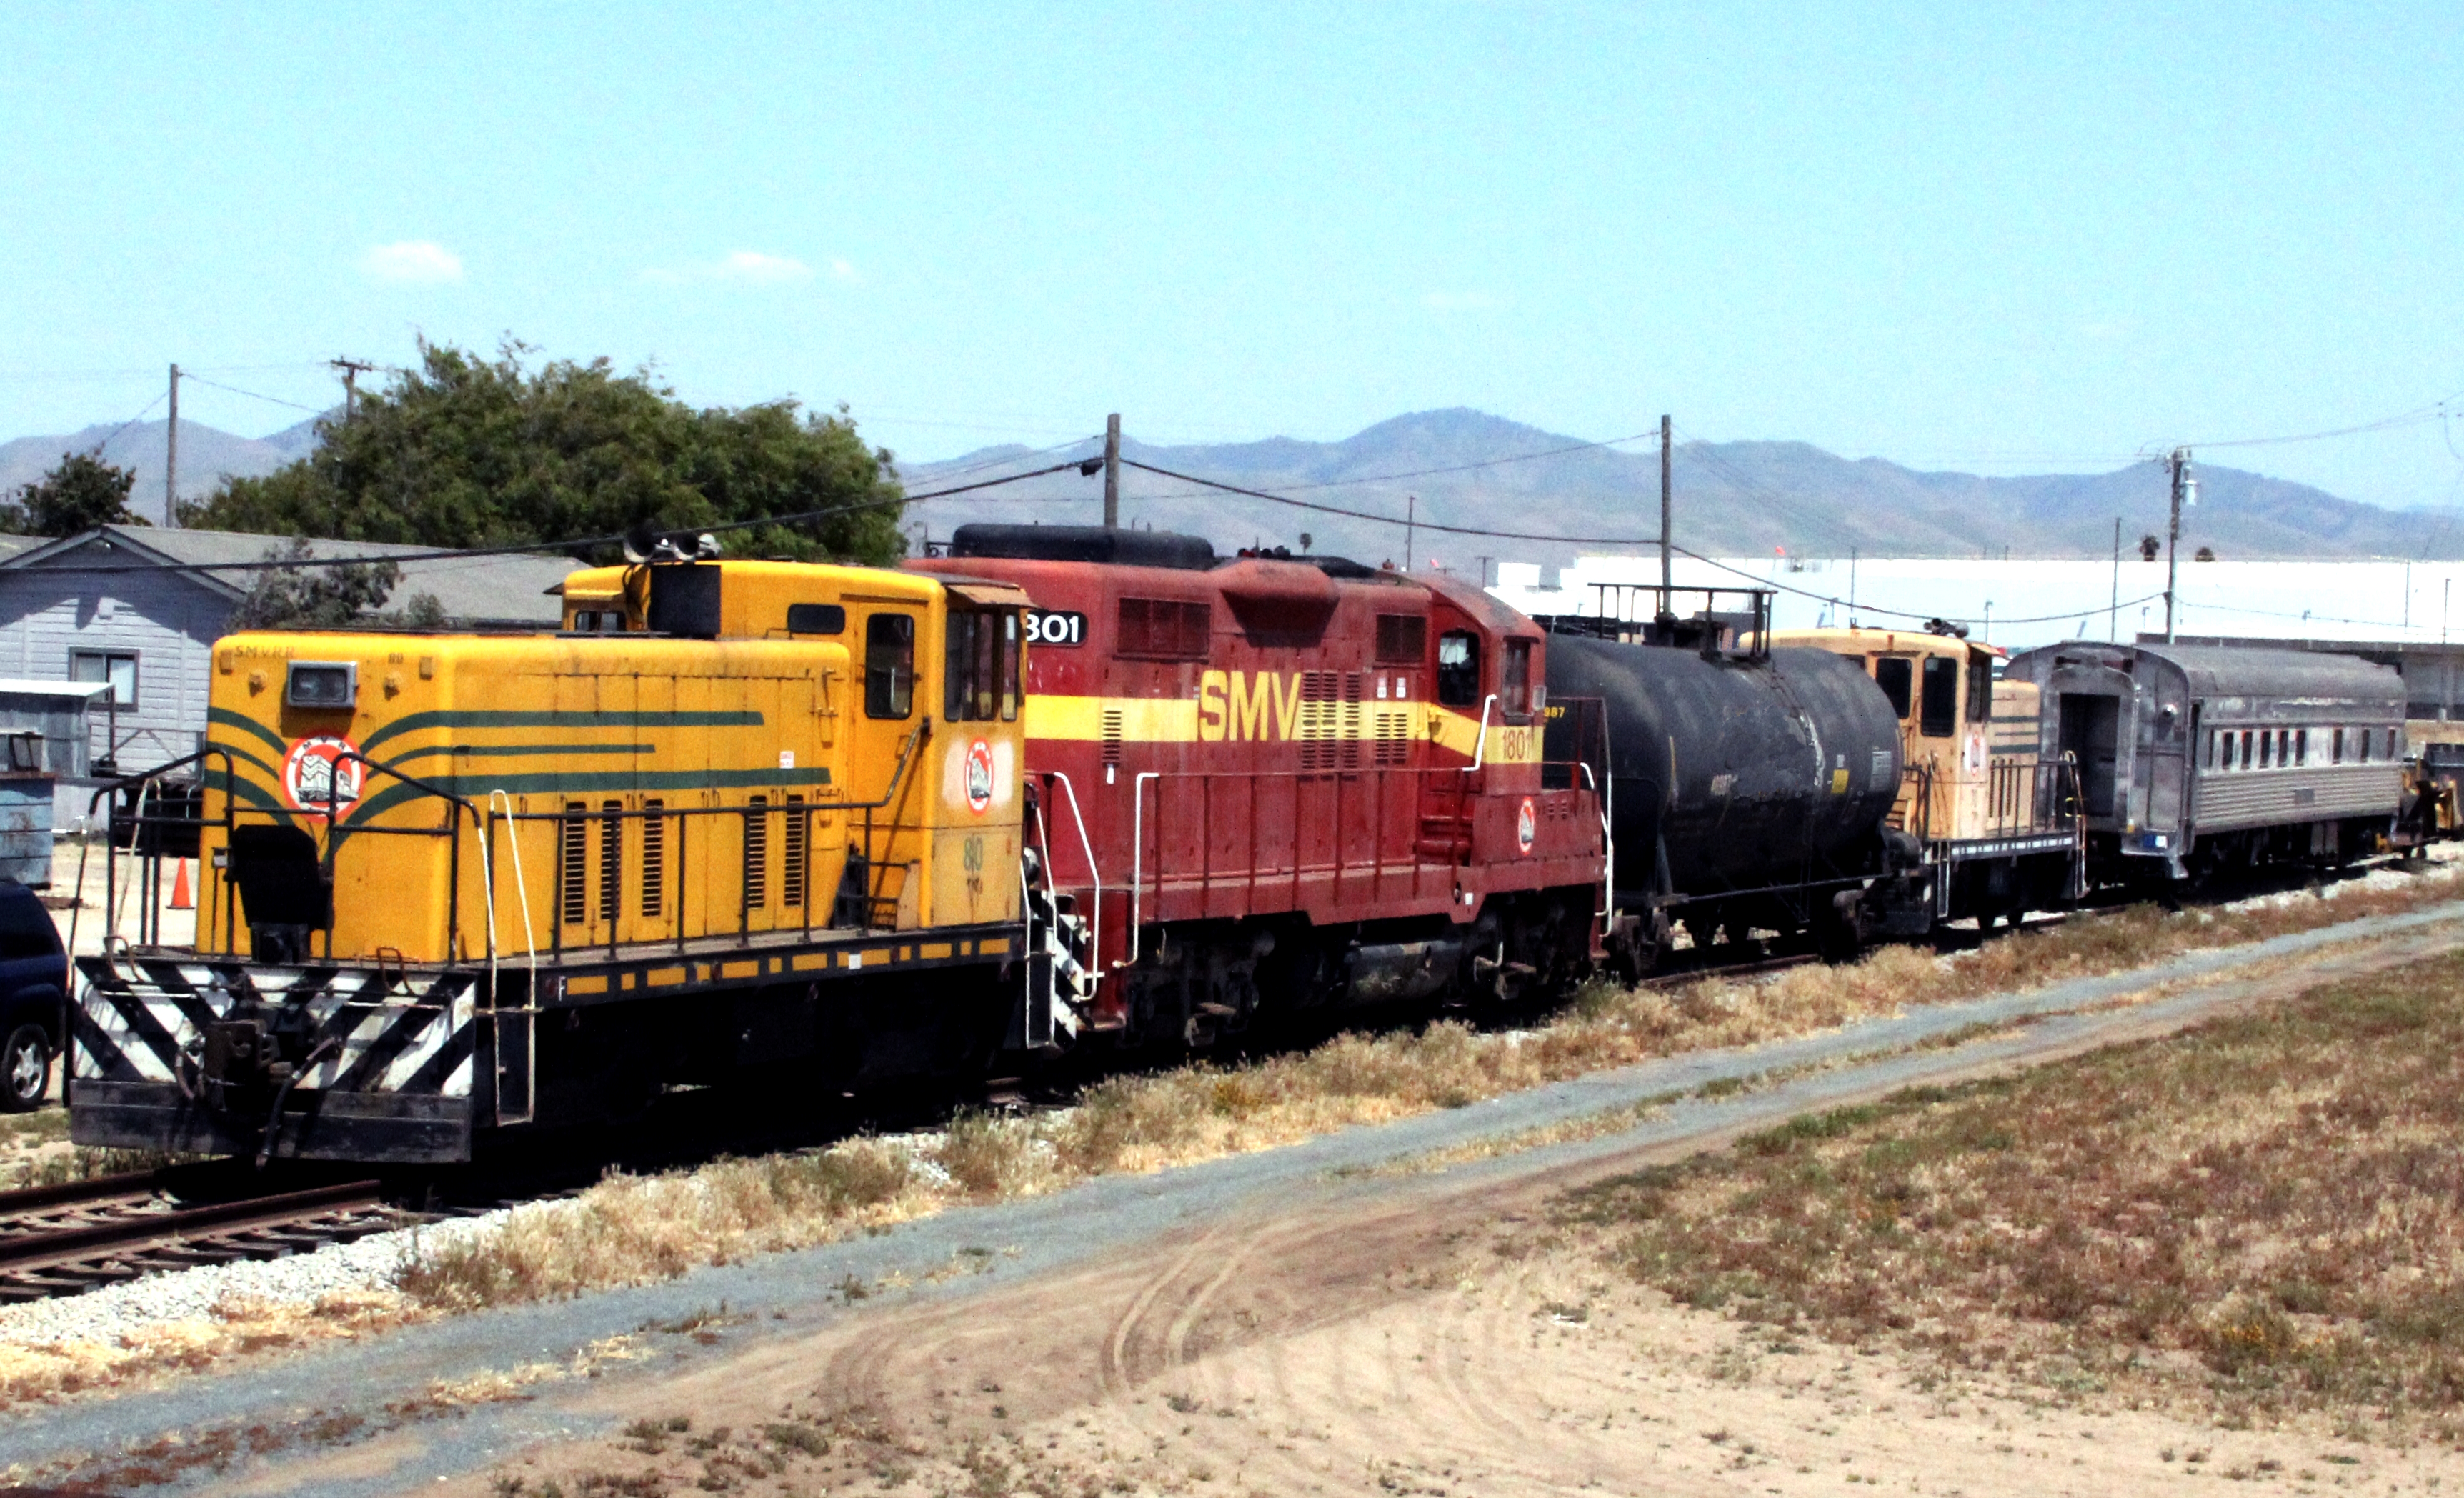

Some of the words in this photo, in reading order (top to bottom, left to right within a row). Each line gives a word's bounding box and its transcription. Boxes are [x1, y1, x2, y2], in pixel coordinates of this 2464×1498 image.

[1199, 670, 1302, 741] SMV
[1503, 729, 1530, 759] 1801
[963, 837, 983, 871] 80
[558, 976, 566, 1001] F
